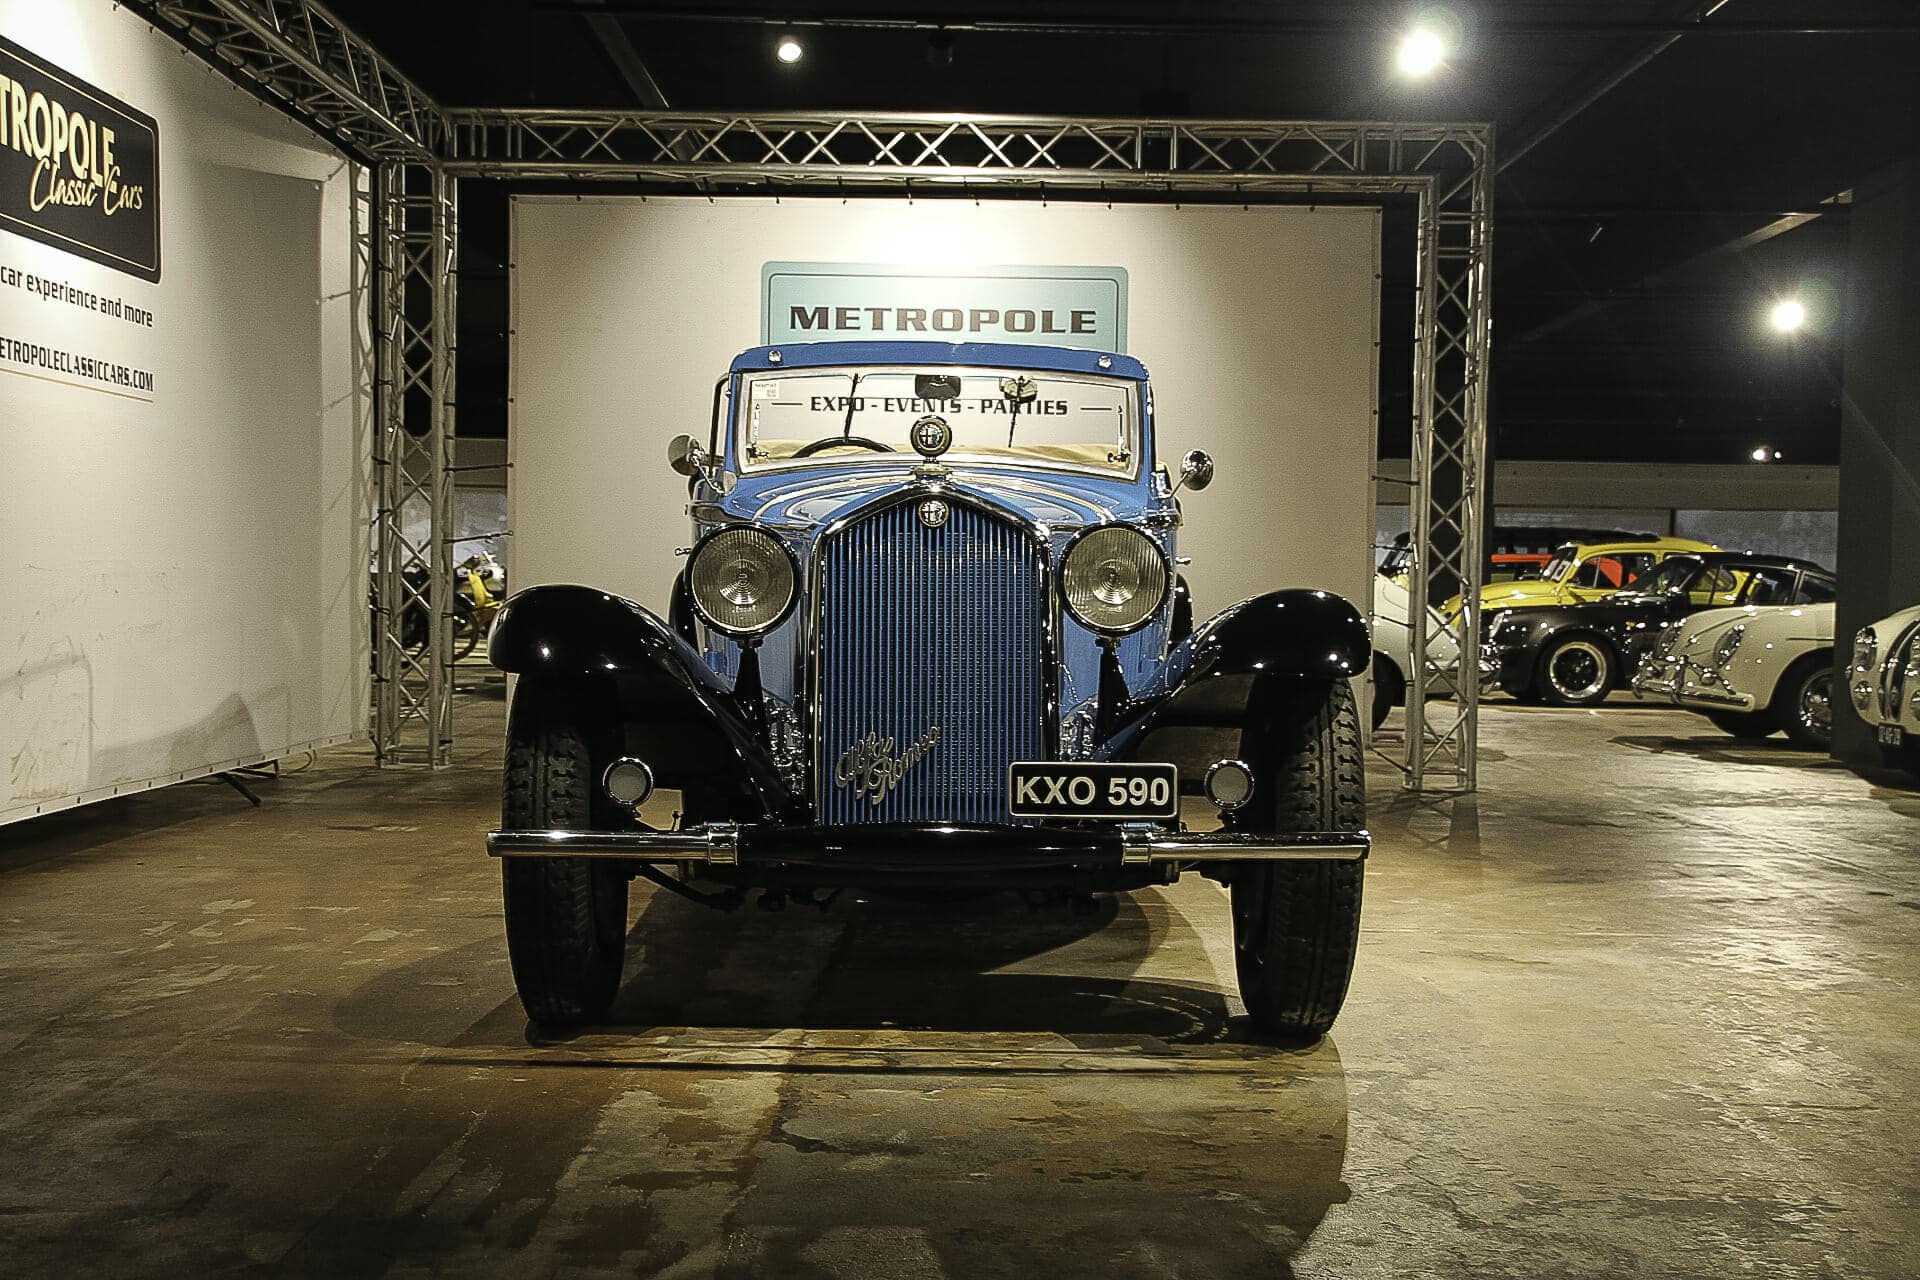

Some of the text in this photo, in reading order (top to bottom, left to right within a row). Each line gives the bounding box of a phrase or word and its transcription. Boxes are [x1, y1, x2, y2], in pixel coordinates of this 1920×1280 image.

[30, 157, 143, 216] Classic Cars
[0, 265, 153, 328] car experience and more
[790, 305, 1097, 334] METROPOLE
[810, 396, 865, 412] EXPO
[884, 397, 962, 413] EVENTS
[1016, 776, 1170, 806] KXO 590
